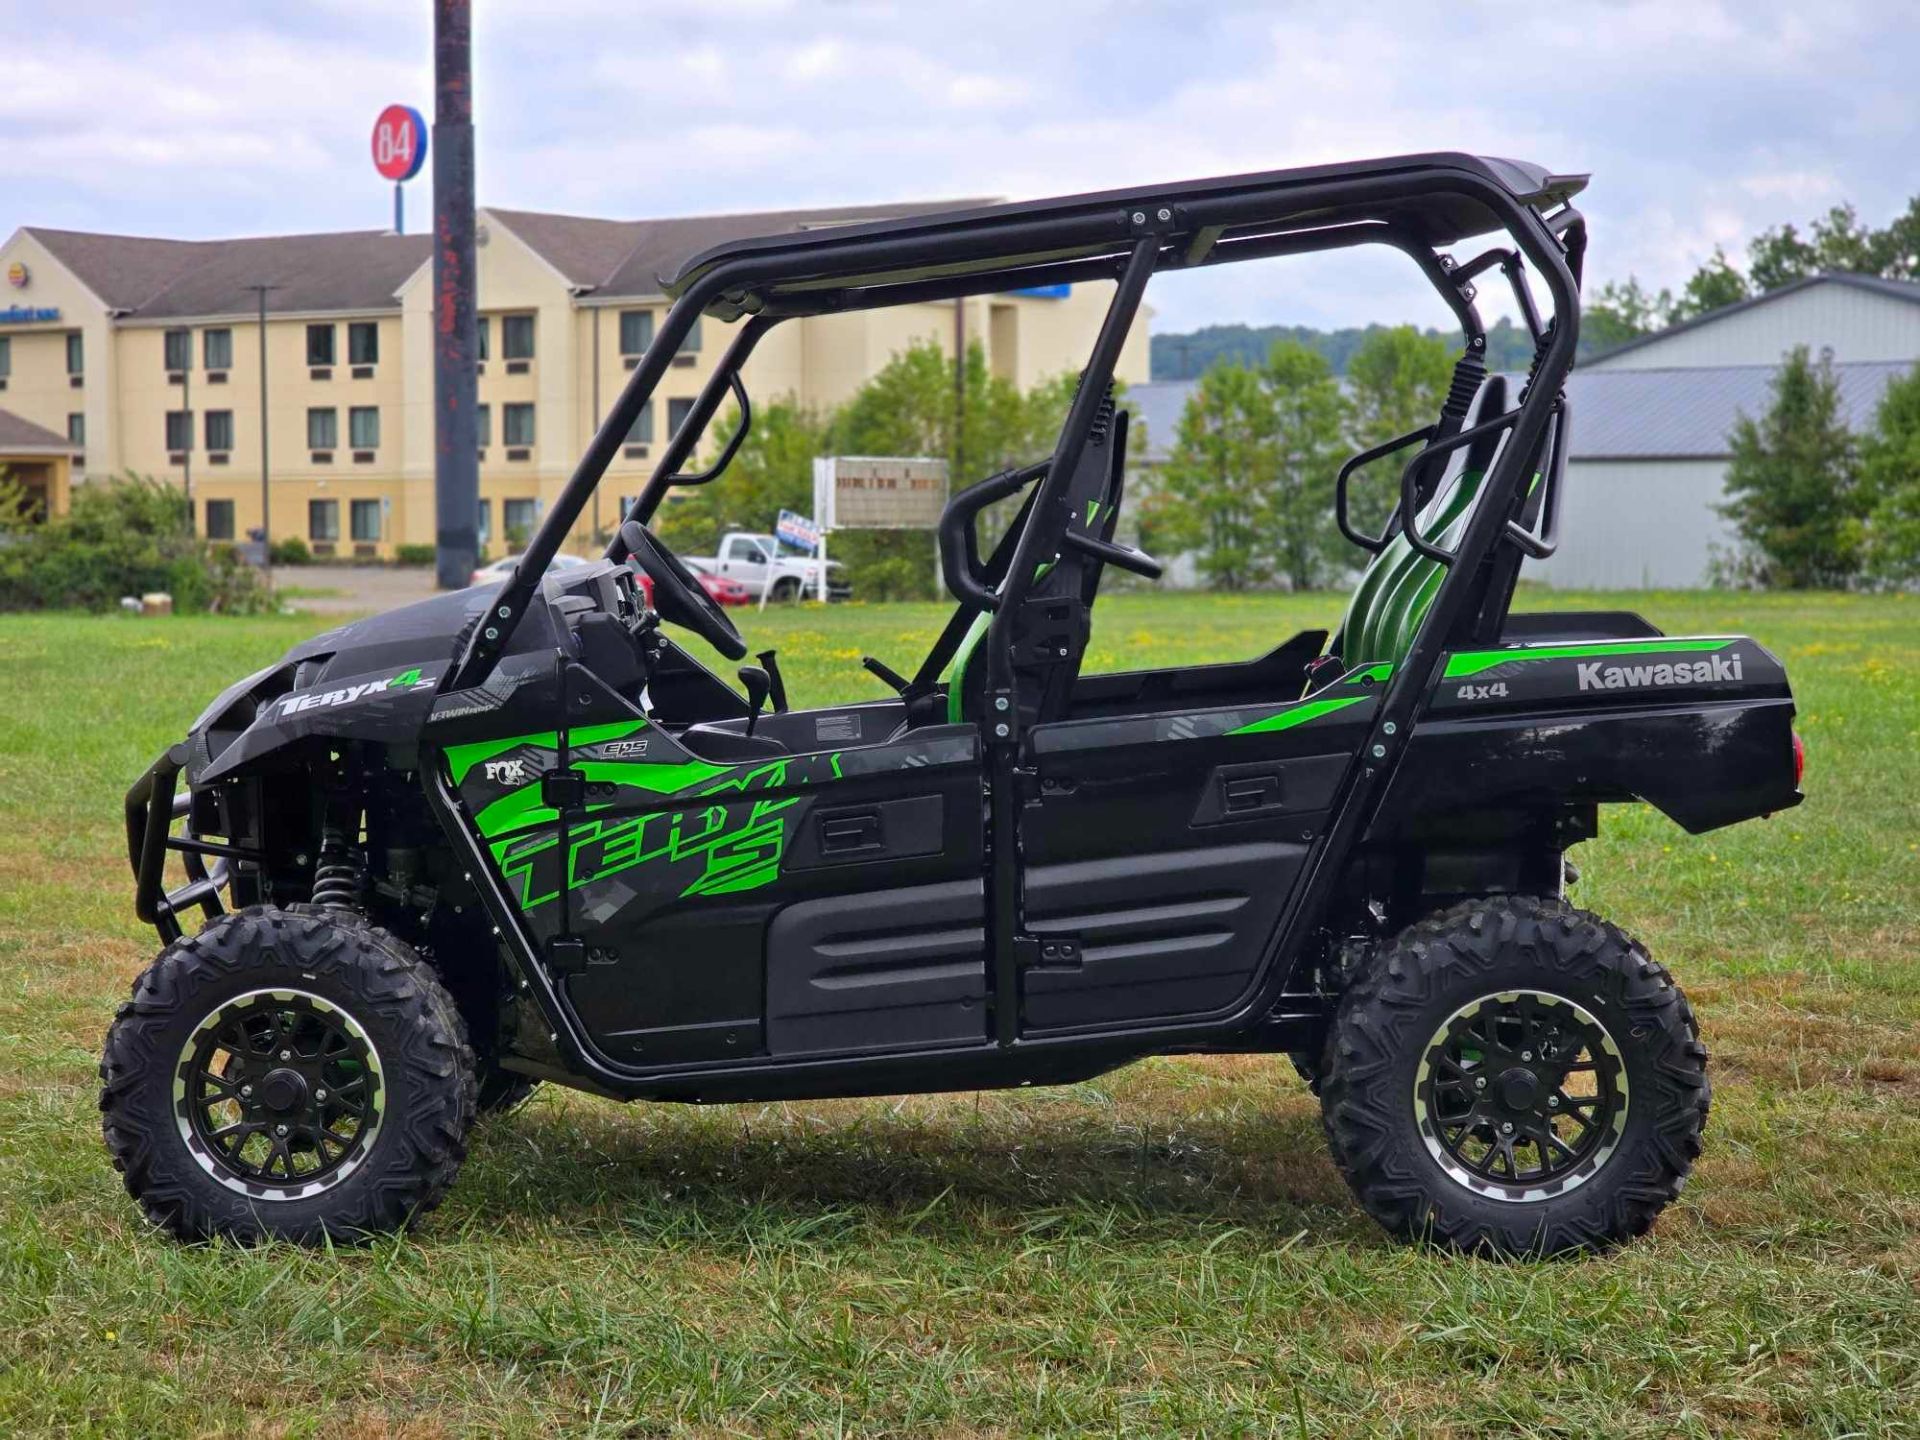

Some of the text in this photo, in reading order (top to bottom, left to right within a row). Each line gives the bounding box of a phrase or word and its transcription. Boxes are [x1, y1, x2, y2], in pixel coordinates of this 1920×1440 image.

[379, 121, 410, 164] 84
[1577, 653, 1743, 690] Kawasaki
[1457, 682, 1509, 700] 4x4
[603, 740, 648, 756] EPS
[485, 760, 525, 786] FOX
